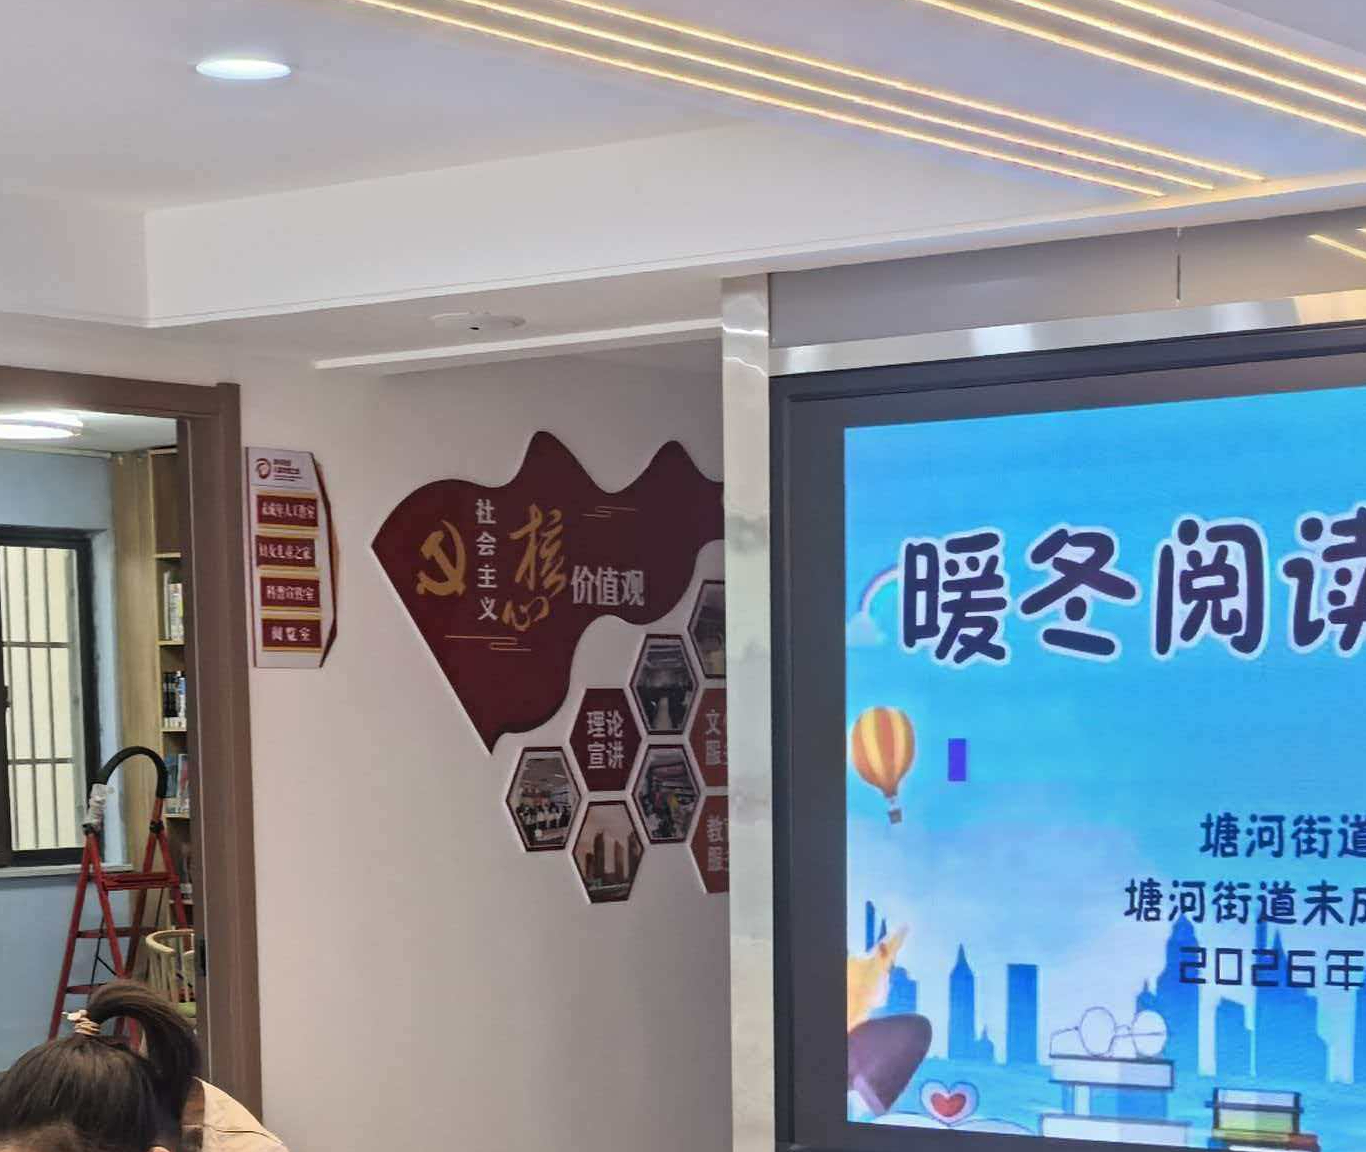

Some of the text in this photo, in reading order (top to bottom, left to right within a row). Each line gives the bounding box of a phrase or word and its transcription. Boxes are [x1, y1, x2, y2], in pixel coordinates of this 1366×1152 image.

[475, 498, 498, 621] 社会主义
[502, 503, 566, 632] 核心
[570, 564, 645, 608] 价值观
